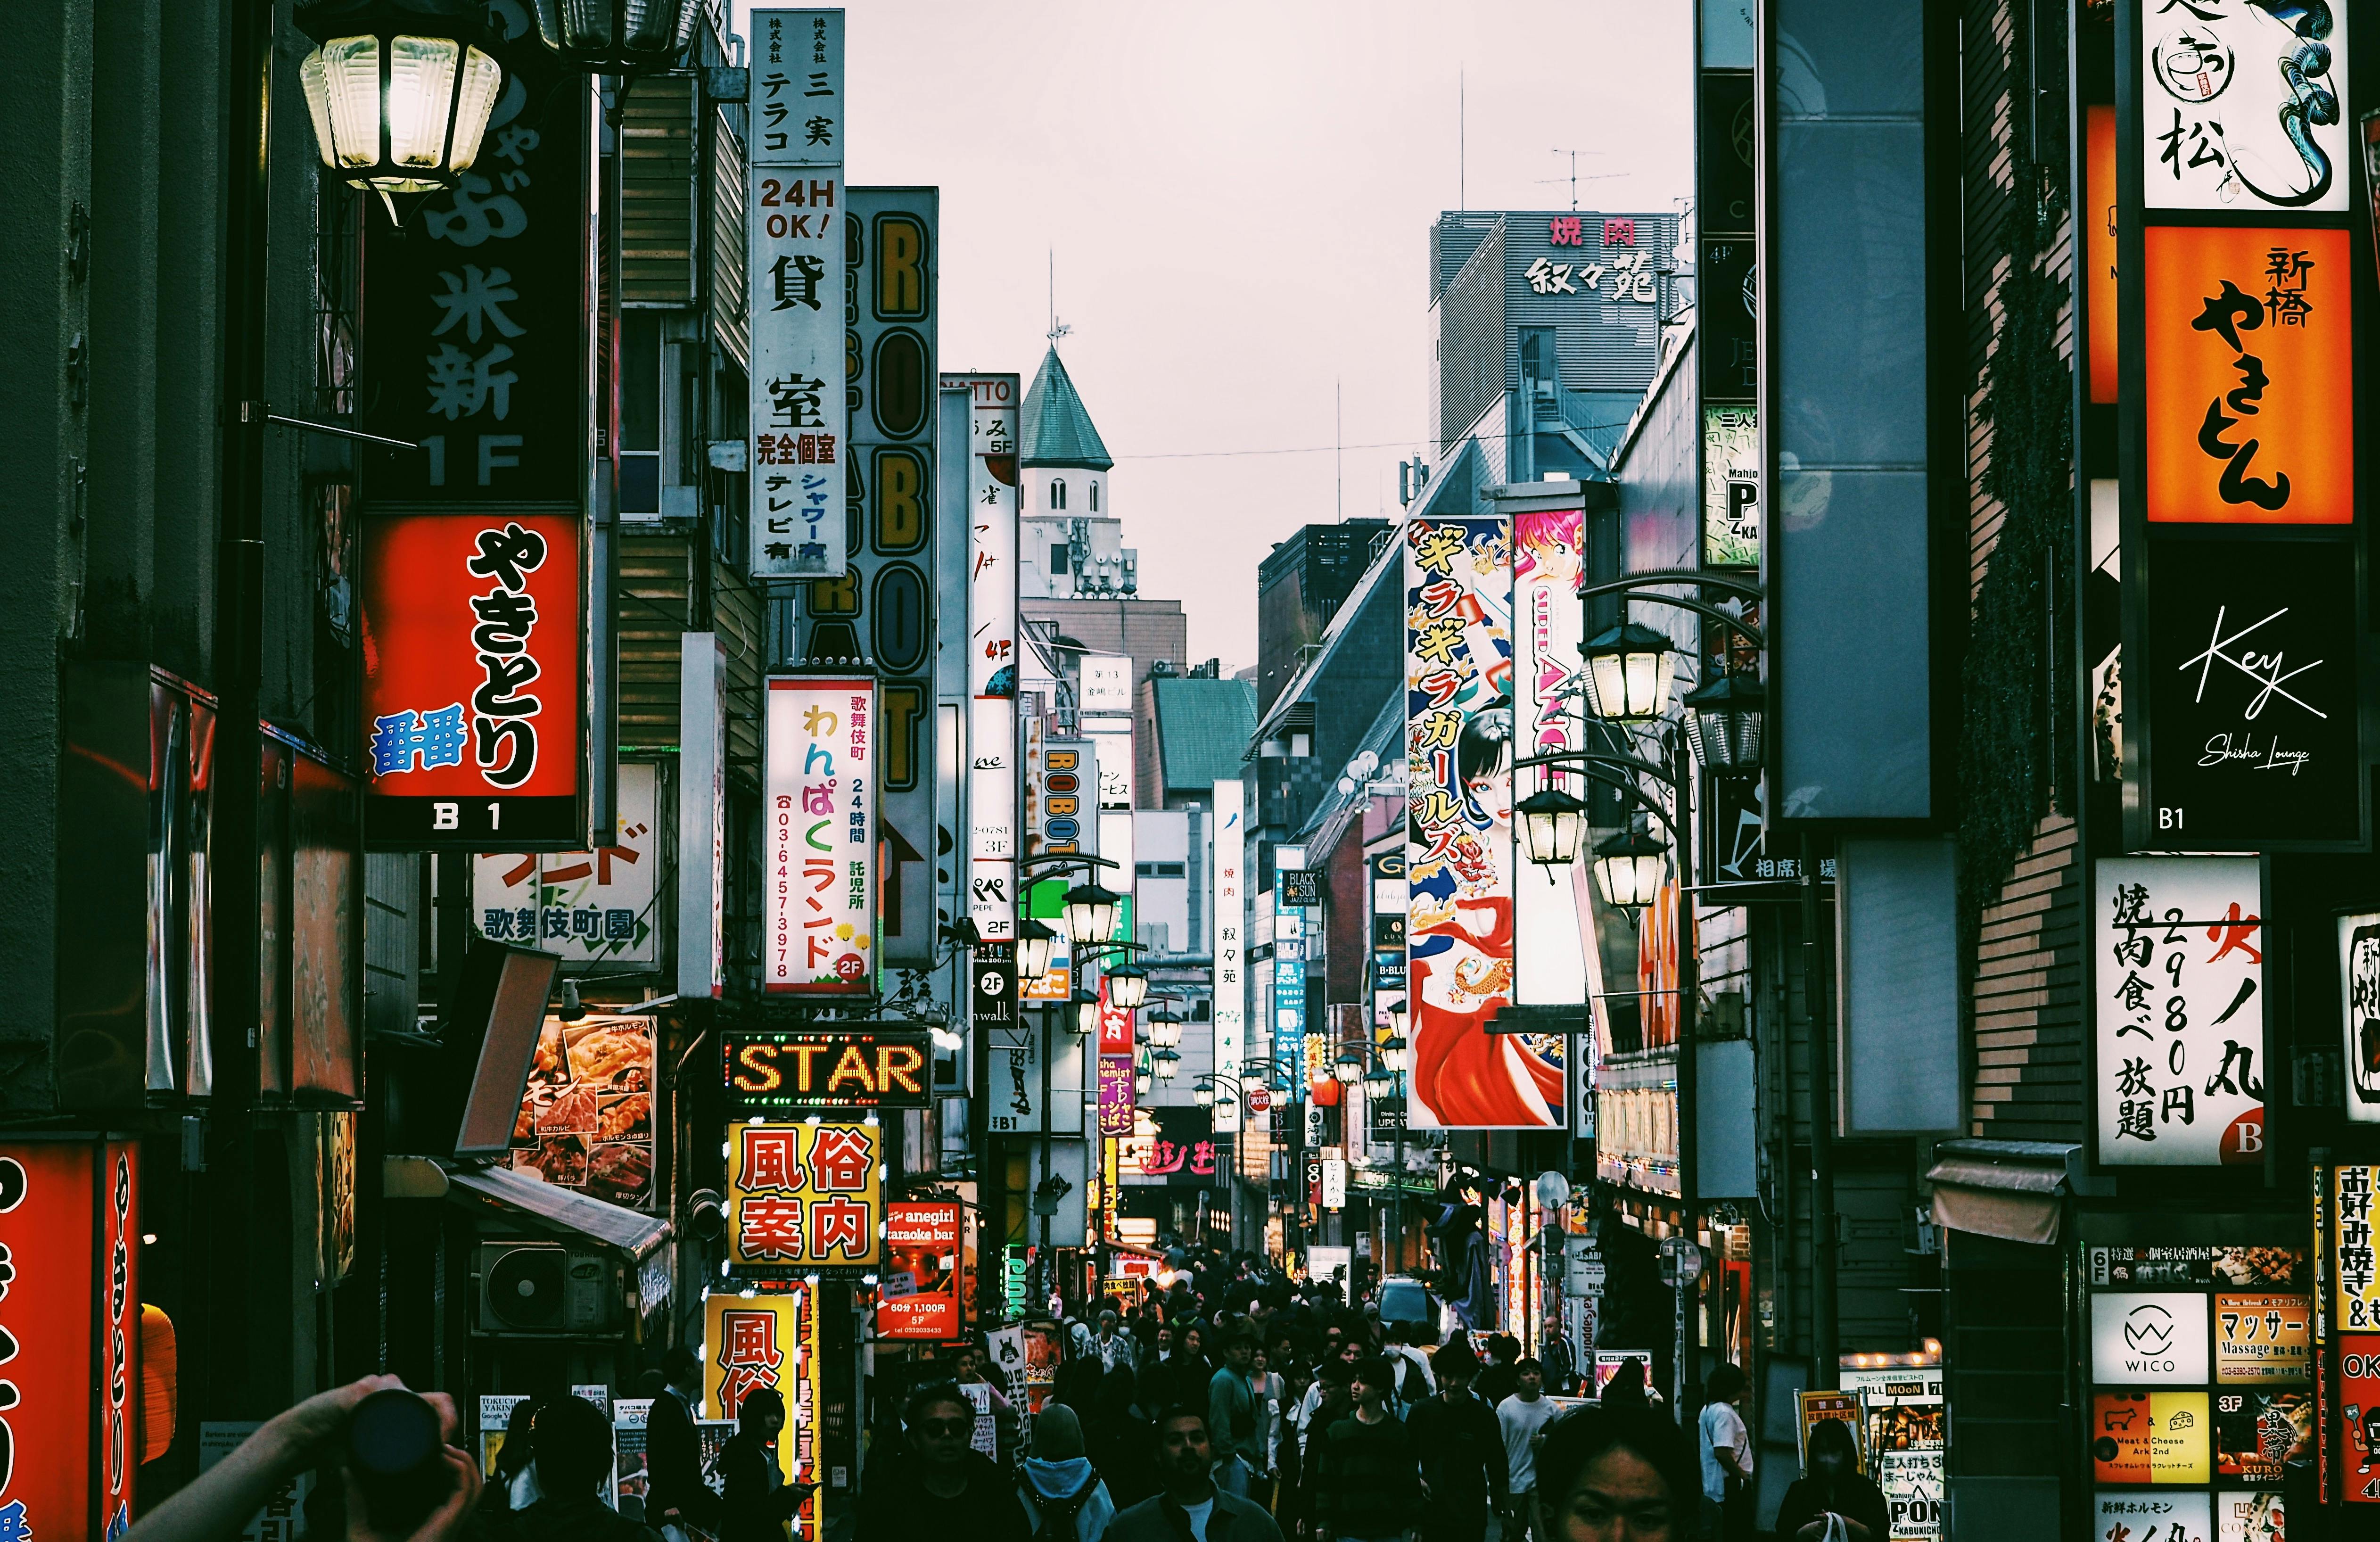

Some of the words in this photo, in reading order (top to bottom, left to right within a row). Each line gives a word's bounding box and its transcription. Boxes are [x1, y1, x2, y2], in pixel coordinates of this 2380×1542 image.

[769, 17, 782, 64] 株式会社
[813, 17, 827, 64] 株式会社
[761, 72, 791, 151] テラコ
[803, 72, 834, 147] 三実
[761, 180, 834, 207] 24H
[766, 214, 830, 240] OK!
[1549, 215, 1635, 247] 焼肉
[1524, 249, 1657, 303] 叙々苑
[2265, 247, 2315, 329] 新橋
[2191, 279, 2291, 511] やきとん
[419, 435, 524, 486] 1F
[757, 433, 836, 466] 完全個室
[990, 440, 1012, 453] 5F
[871, 211, 930, 793] ROBOT
[466, 522, 548, 790] やきとり
[985, 640, 1012, 661] 4F
[2179, 605, 2327, 720] Key
[1416, 524, 1466, 863] ギラギラガールズ
[850, 696, 866, 761] 歌舞伎町
[2198, 733, 2261, 766] Shisha
[2254, 735, 2310, 776] Lounge
[849, 778, 865, 844] 24時間
[2158, 808, 2183, 830] B1
[802, 704, 838, 969] わんぱくランド
[985, 840, 1007, 853] 3F
[1223, 868, 1235, 897] 焼肉
[1289, 873, 1316, 885] BLACK
[1755, 858, 1836, 878] 相席場
[776, 813, 789, 978] 03-6457-3978
[849, 861, 865, 910] 託児所
[1299, 885, 1316, 897] SUN
[484, 908, 635, 939] 歌舞伎町園
[988, 921, 1010, 933] 2F
[840, 959, 861, 975] 2F
[1222, 926, 1236, 983] 叙々苑
[984, 977, 1001, 990] 2F
[2112, 883, 2157, 1142] 焼肉食べ放題
[2161, 908, 2194, 1125] 2980円
[2204, 902, 2264, 1103] 火ノ丸
[734, 1044, 923, 1093] STAR
[1250, 1096, 1269, 1106] 消火栓
[1000, 1116, 1017, 1130] B1
[735, 1126, 874, 1192] 風俗
[1329, 1162, 1340, 1204] とんかつ
[738, 1194, 871, 1261] 案内
[905, 1209, 955, 1226] anegirl
[934, 1228, 955, 1240] bar
[2094, 1251, 2106, 1282] 6F
[110, 1151, 130, 1496] やきとり
[890, 1303, 911, 1313] 60分
[914, 1303, 946, 1313] 1,100円
[911, 1316, 925, 1324] 5F
[2220, 1310, 2310, 1342] マッサー
[2125, 1360, 2175, 1372] WICO
[2222, 1341, 2270, 1359] Massage
[2218, 1395, 2242, 1412] 3F
[2242, 1465, 2282, 1474] KURO
[2101, 1501, 2173, 1514] 新鮮ホルモン
